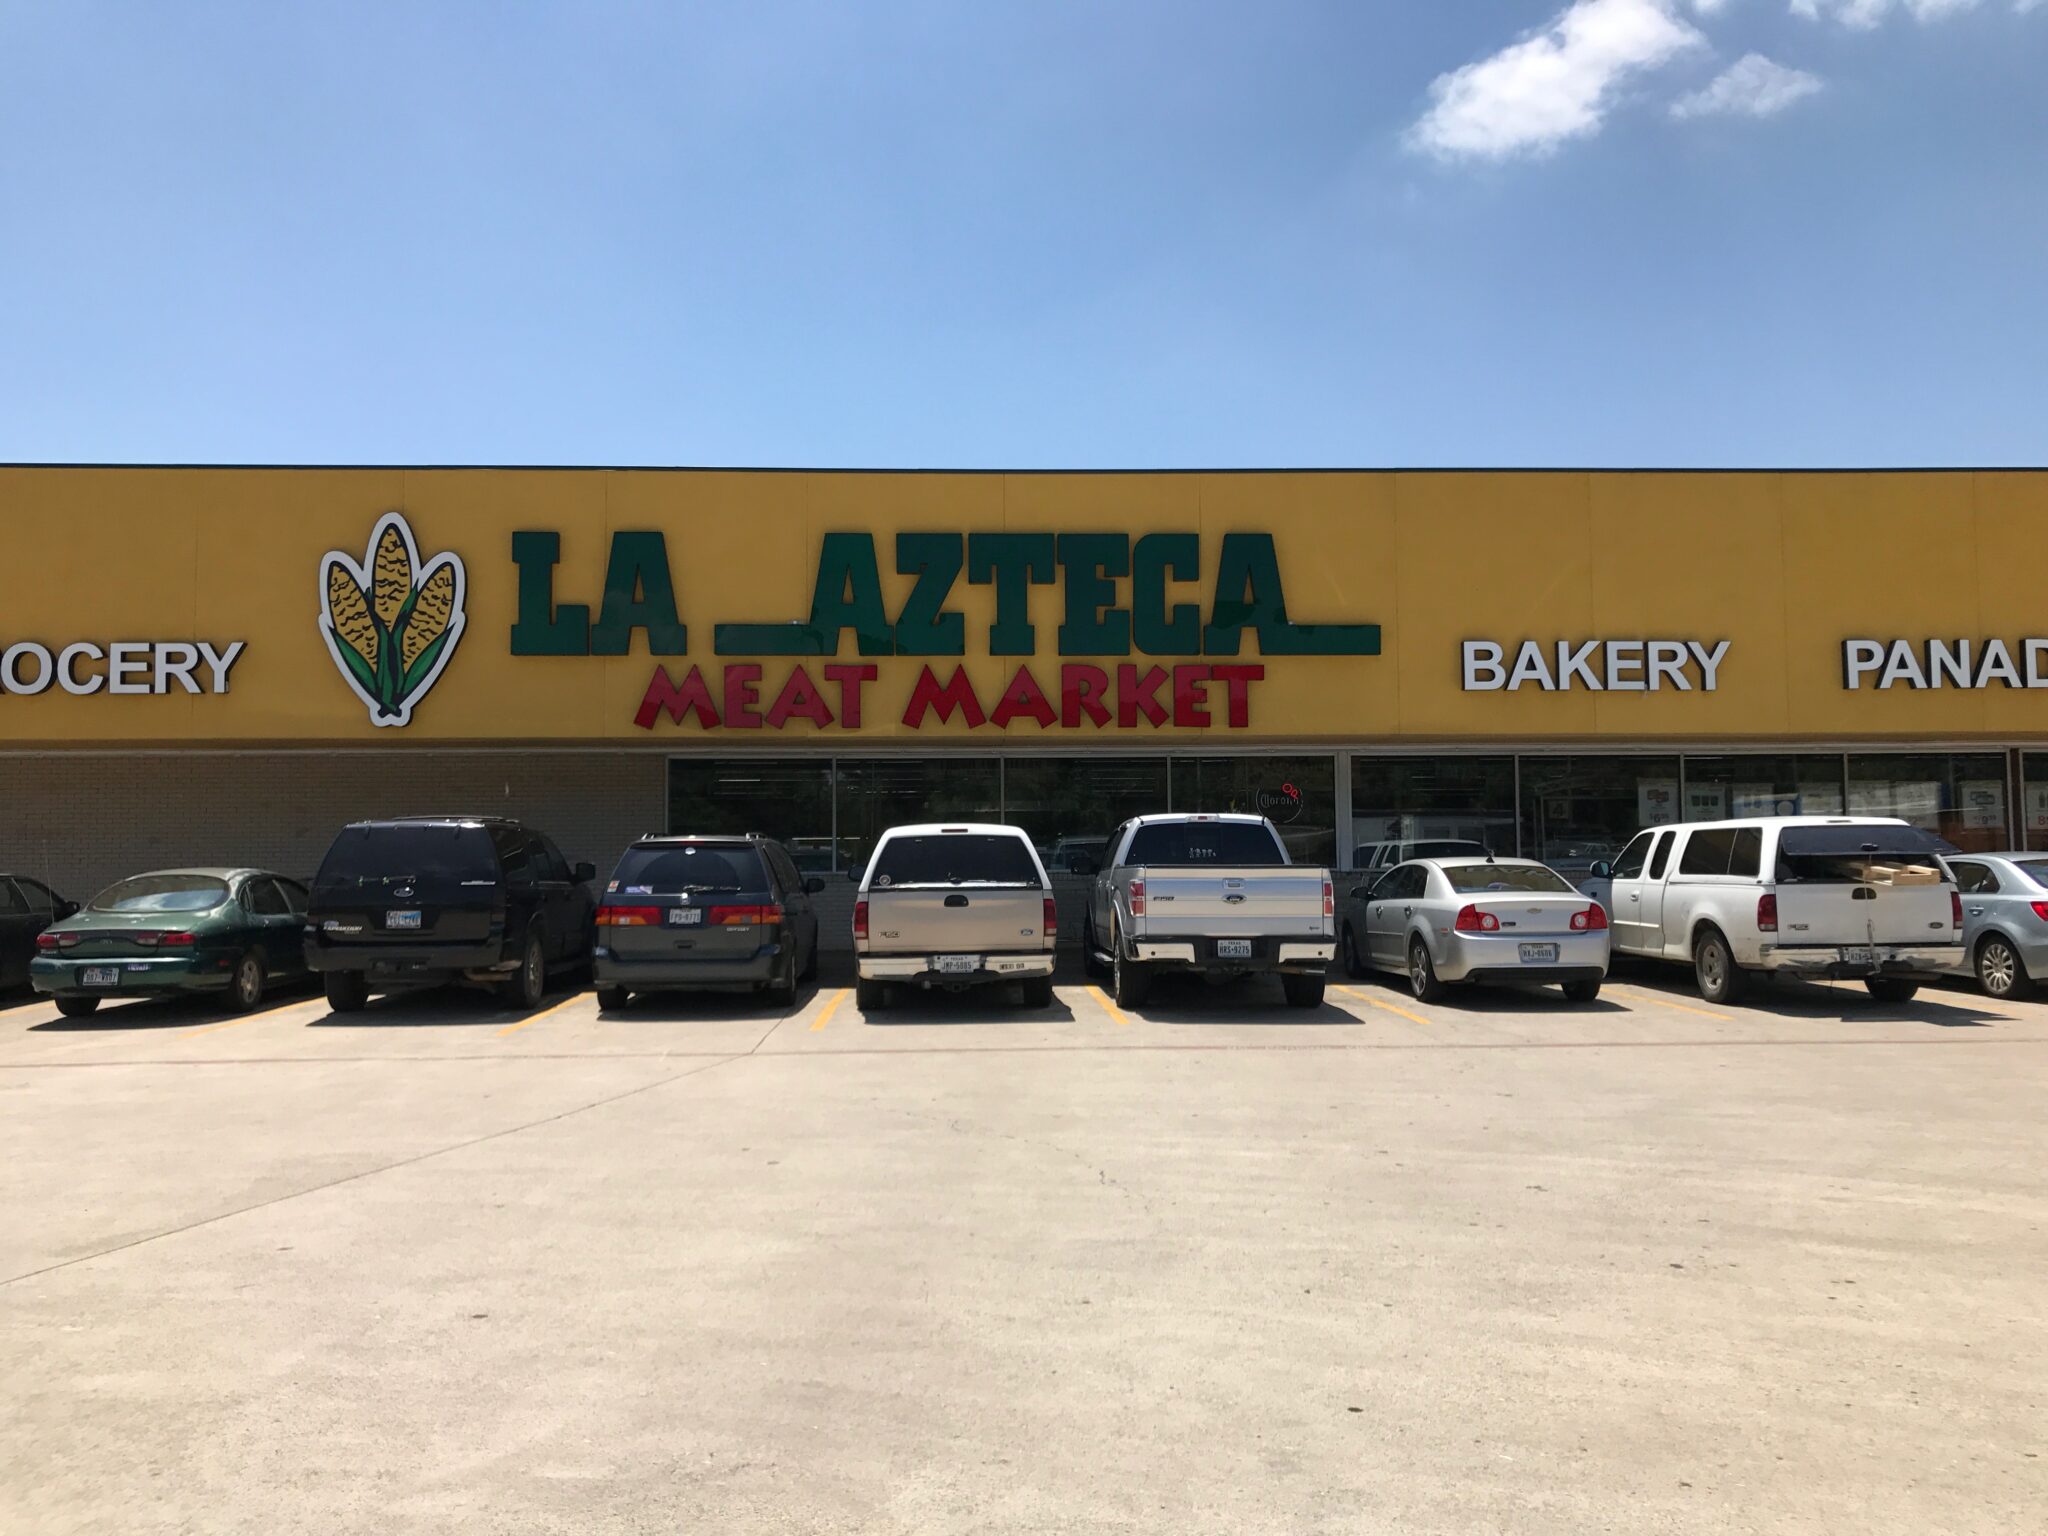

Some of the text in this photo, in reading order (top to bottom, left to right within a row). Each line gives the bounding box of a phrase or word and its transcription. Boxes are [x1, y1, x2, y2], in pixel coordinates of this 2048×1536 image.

[510, 531, 1381, 656] LA AZTECA
[0, 641, 245, 695] OCERY
[1461, 640, 1732, 691] BAKERY
[634, 664, 1265, 730] MEAT MARKET
